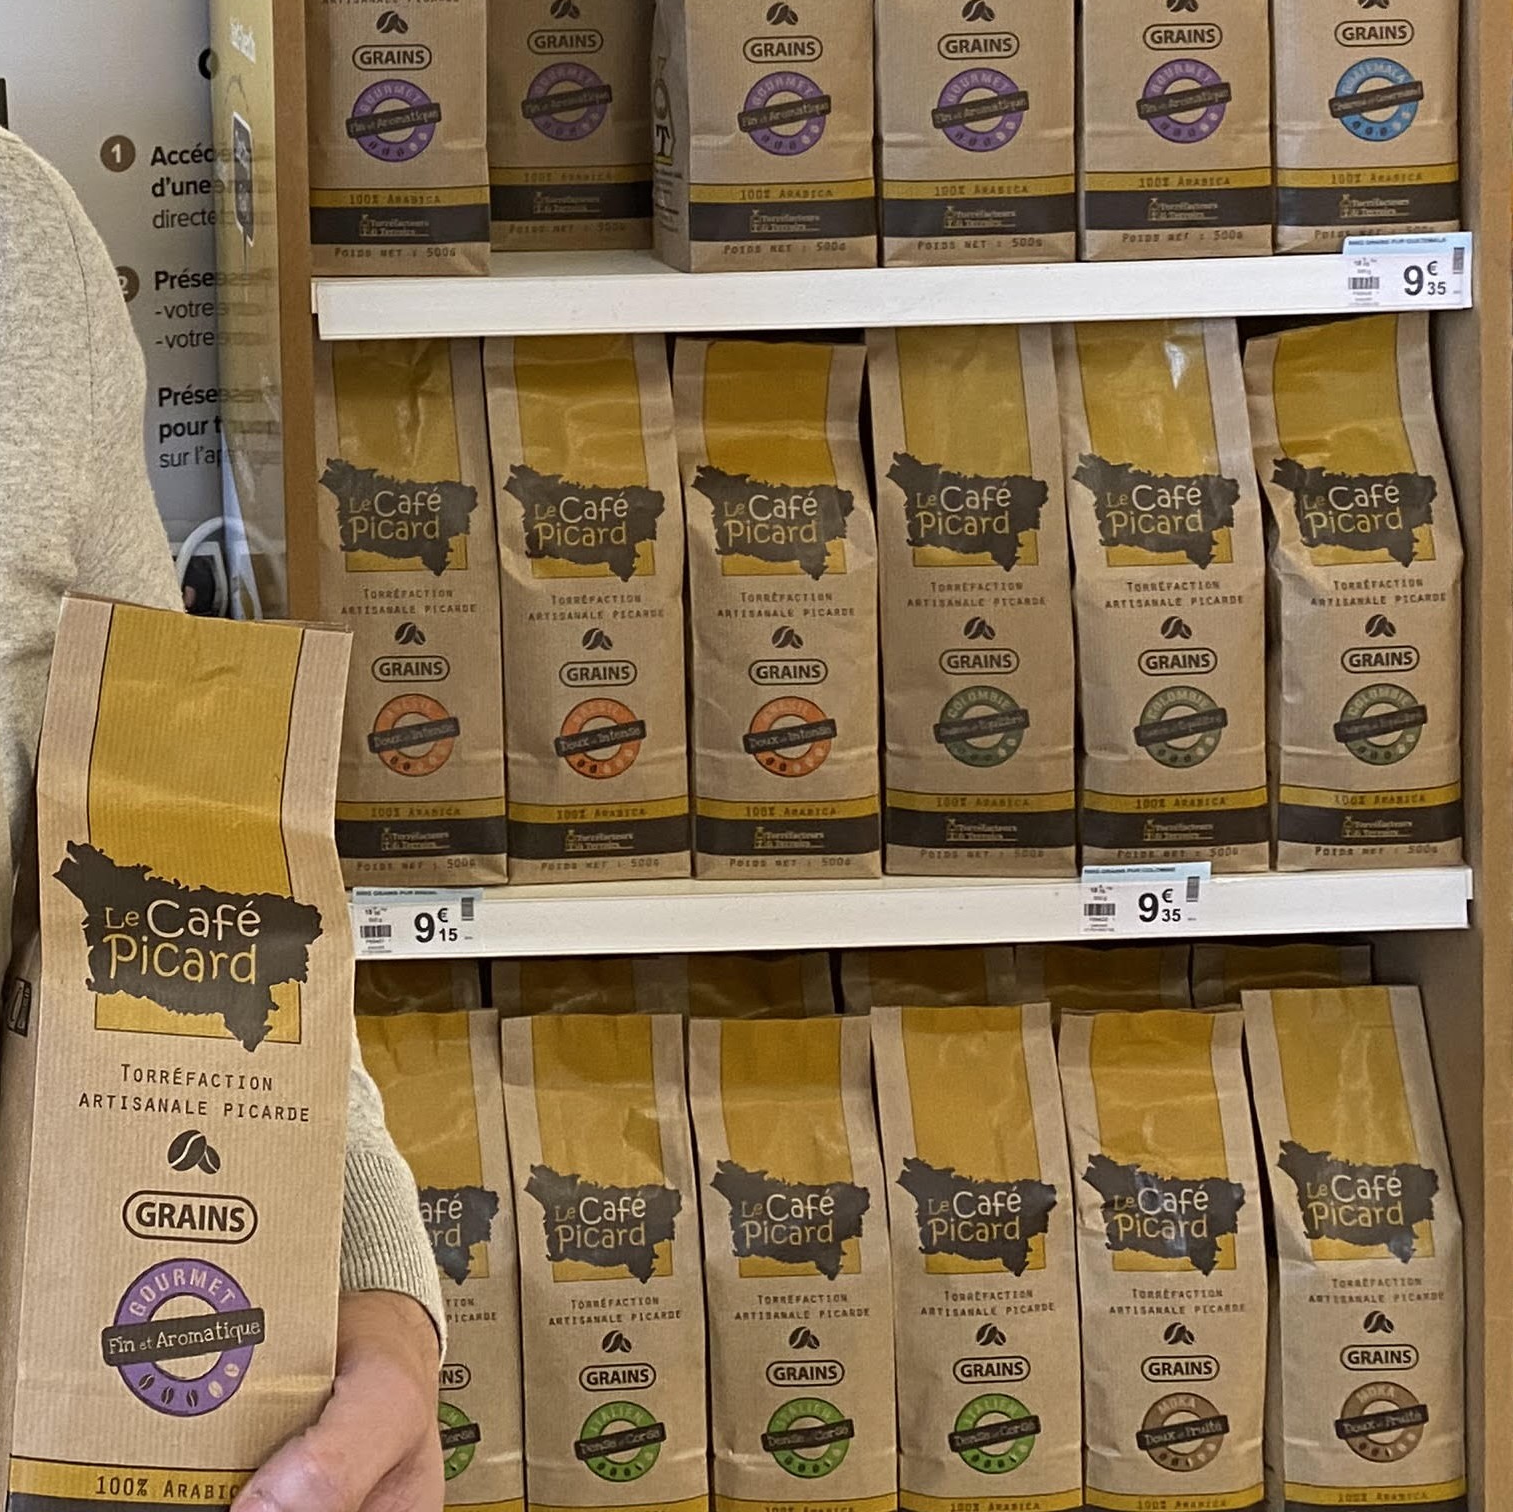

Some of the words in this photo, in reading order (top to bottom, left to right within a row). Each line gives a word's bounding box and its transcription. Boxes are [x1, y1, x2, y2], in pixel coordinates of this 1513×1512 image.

[945, 37, 1012, 56] GRAINS
[1342, 24, 1407, 42] GRAINS
[750, 40, 816, 58] GRAINS
[111, 143, 121, 163] 1
[152, 209, 216, 229] directe
[155, 269, 215, 291] Prése
[1404, 265, 1424, 296] 9
[1428, 281, 1446, 295] 35
[158, 385, 218, 407] Prése
[159, 418, 208, 444] pour
[159, 452, 189, 469] sur
[375, 489, 442, 517] Café
[559, 491, 629, 523] Café
[940, 484, 1011, 513] Café
[1328, 479, 1400, 510] Café
[348, 515, 440, 543] Picard
[534, 519, 627, 548] Picard
[916, 510, 1010, 538] Picard
[1305, 508, 1403, 536] Picard
[378, 660, 444, 678] GRAINS
[566, 663, 631, 682] GRAINS
[946, 652, 1012, 670] GRAINS
[1348, 649, 1413, 668] GRAINS
[103, 905, 140, 931] Le
[146, 898, 261, 940] Café
[1138, 892, 1159, 923] 9
[1162, 908, 1181, 922] 35
[414, 912, 435, 943] 9
[439, 928, 457, 941] 15
[102, 933, 259, 985] Picard
[79, 1092, 208, 1117] ARTISANALE
[223, 1100, 311, 1123] PICARDE
[1137, 1186, 1209, 1215] Café
[1331, 1171, 1402, 1202] Café
[136, 1199, 246, 1234] GRAINS
[580, 1193, 645, 1224] Café
[766, 1192, 835, 1221] Café
[1308, 1200, 1403, 1229] Picard
[554, 1223, 645, 1248] Picard
[740, 1220, 833, 1246] Picard
[1114, 1212, 1208, 1240] Picard
[129, 1268, 236, 1317] GOURMET
[108, 1336, 135, 1355] Fin
[139, 1338, 153, 1351] et
[156, 1320, 262, 1349] Aromatique
[1148, 1359, 1213, 1377] GRAINS
[1347, 1347, 1412, 1366] GRAINS
[586, 1367, 650, 1385] GRAINS
[772, 1364, 838, 1383] GRAINS
[95, 1476, 148, 1496] 100%
